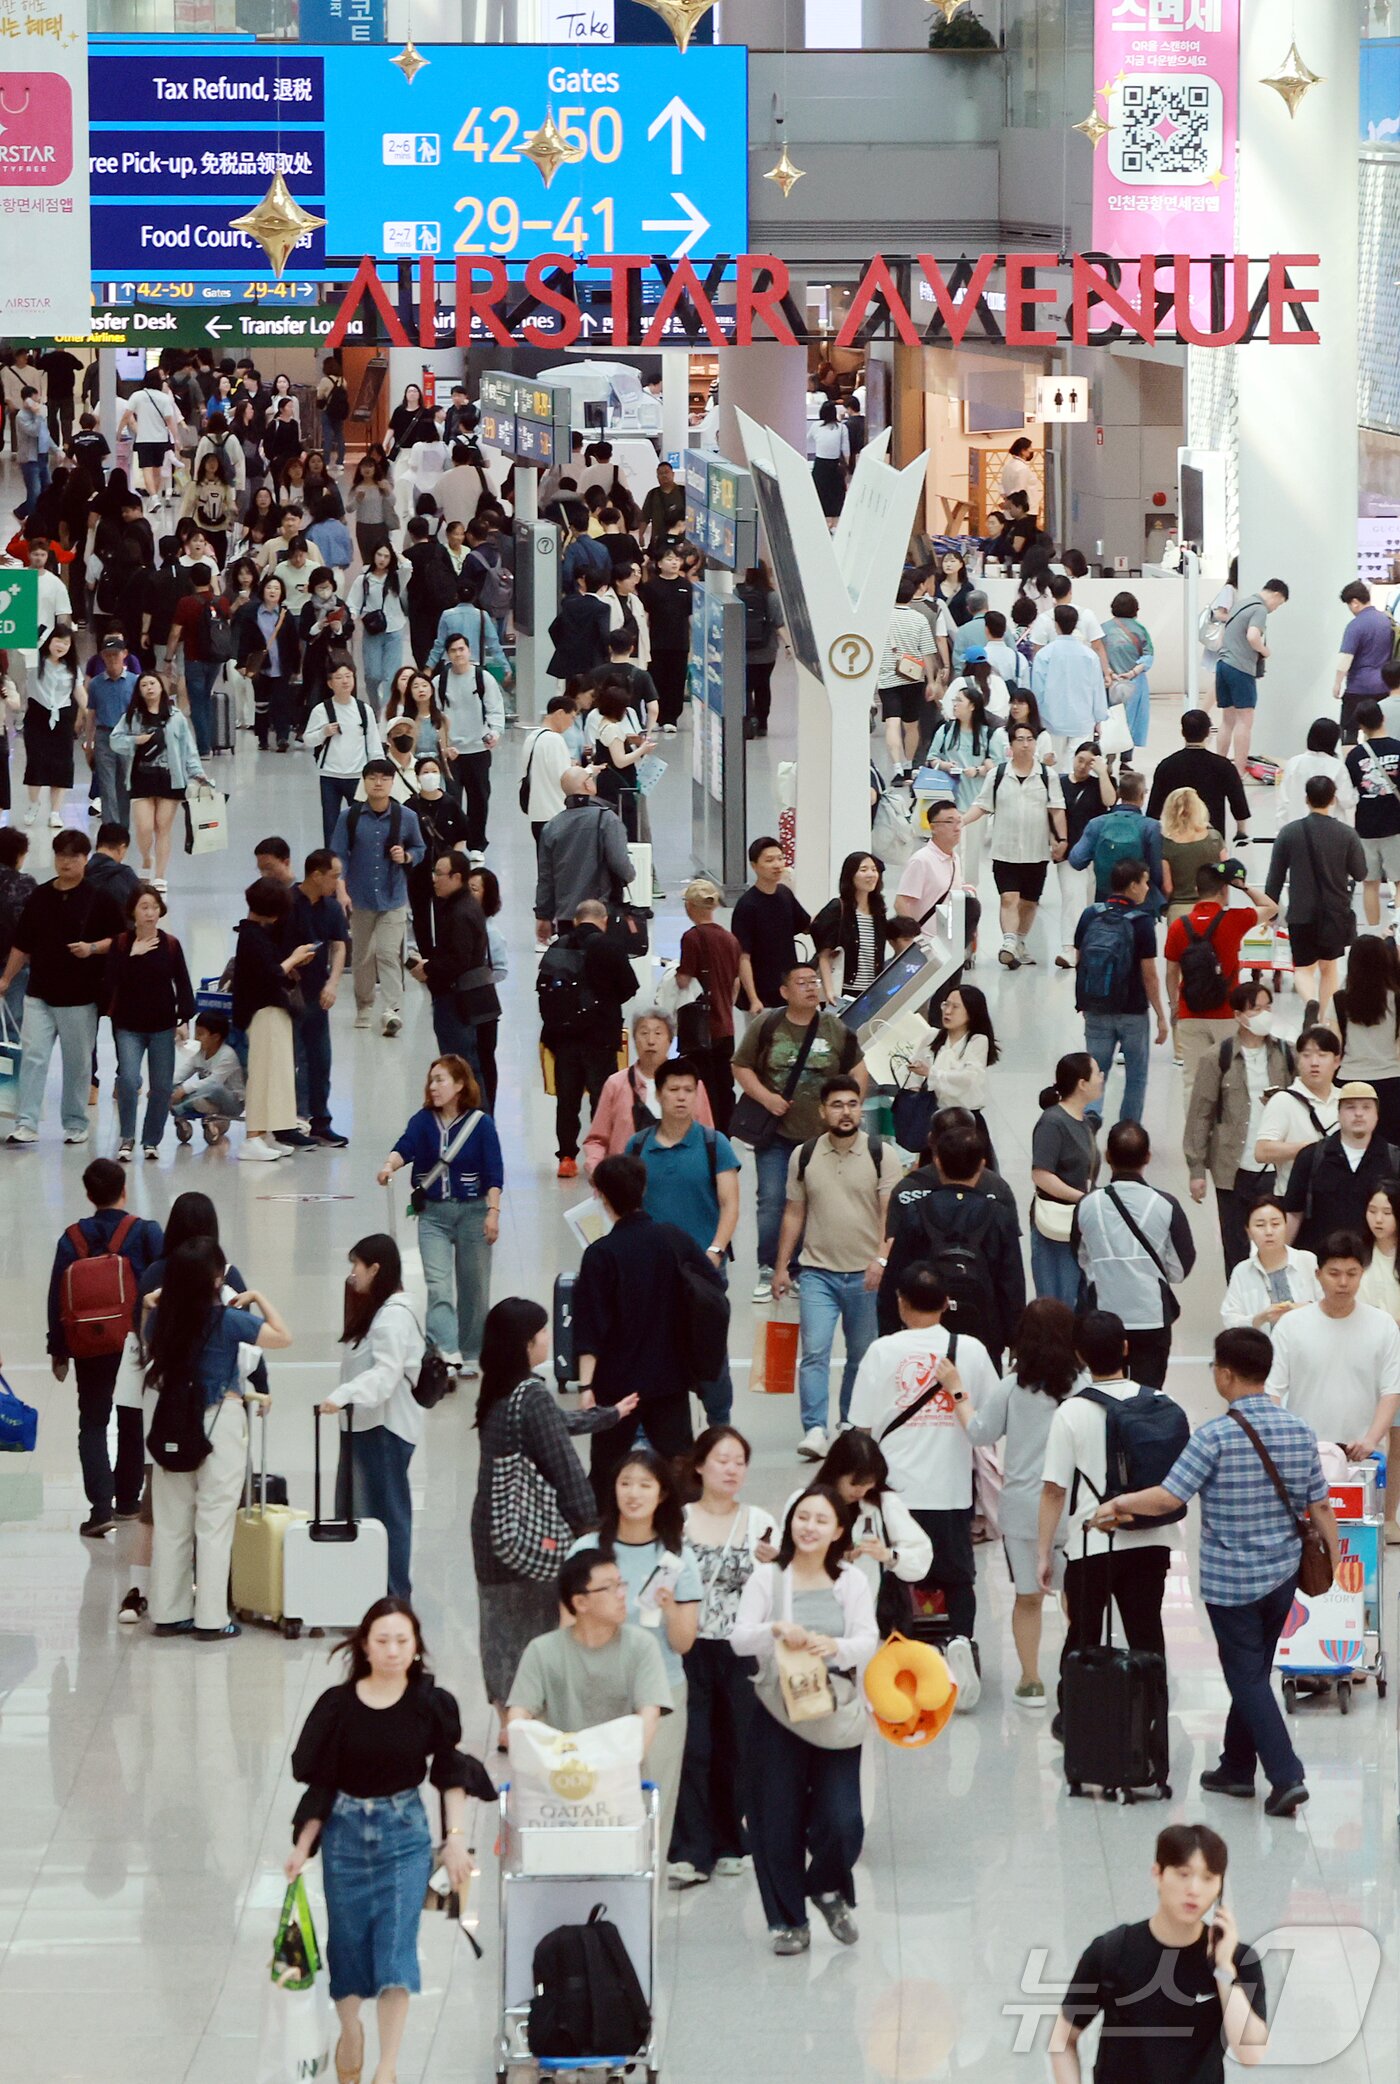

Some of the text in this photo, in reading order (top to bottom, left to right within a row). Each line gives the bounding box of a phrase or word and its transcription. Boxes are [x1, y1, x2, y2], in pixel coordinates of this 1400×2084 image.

[25, 13, 63, 41] 혜택
[556, 10, 611, 39] Take
[1131, 41, 1201, 52] QR을 스캔하여
[1124, 55, 1208, 67] 지금 다운받으세요
[152, 76, 313, 102] Tax Refund, 退税
[547, 66, 621, 93] Gates
[121, 151, 198, 179] Pick-up,
[201, 151, 313, 175] 免税品领取处
[0, 197, 73, 213] 항면세점앱
[453, 196, 615, 253] 29-41
[141, 223, 191, 248] Food
[194, 226, 252, 250] Court,
[388, 228, 411, 241] 2~7
[136, 282, 194, 298] 42-50
[202, 287, 232, 298] Gates
[5, 297, 51, 308] AIRSTAR
[323, 252, 1321, 349] AIRSTAR AVENUE
[133, 312, 178, 330] Desk
[238, 315, 308, 335] Transfer
[86, 331, 127, 343] Airlines
[540, 1801, 610, 1818] QATAR
